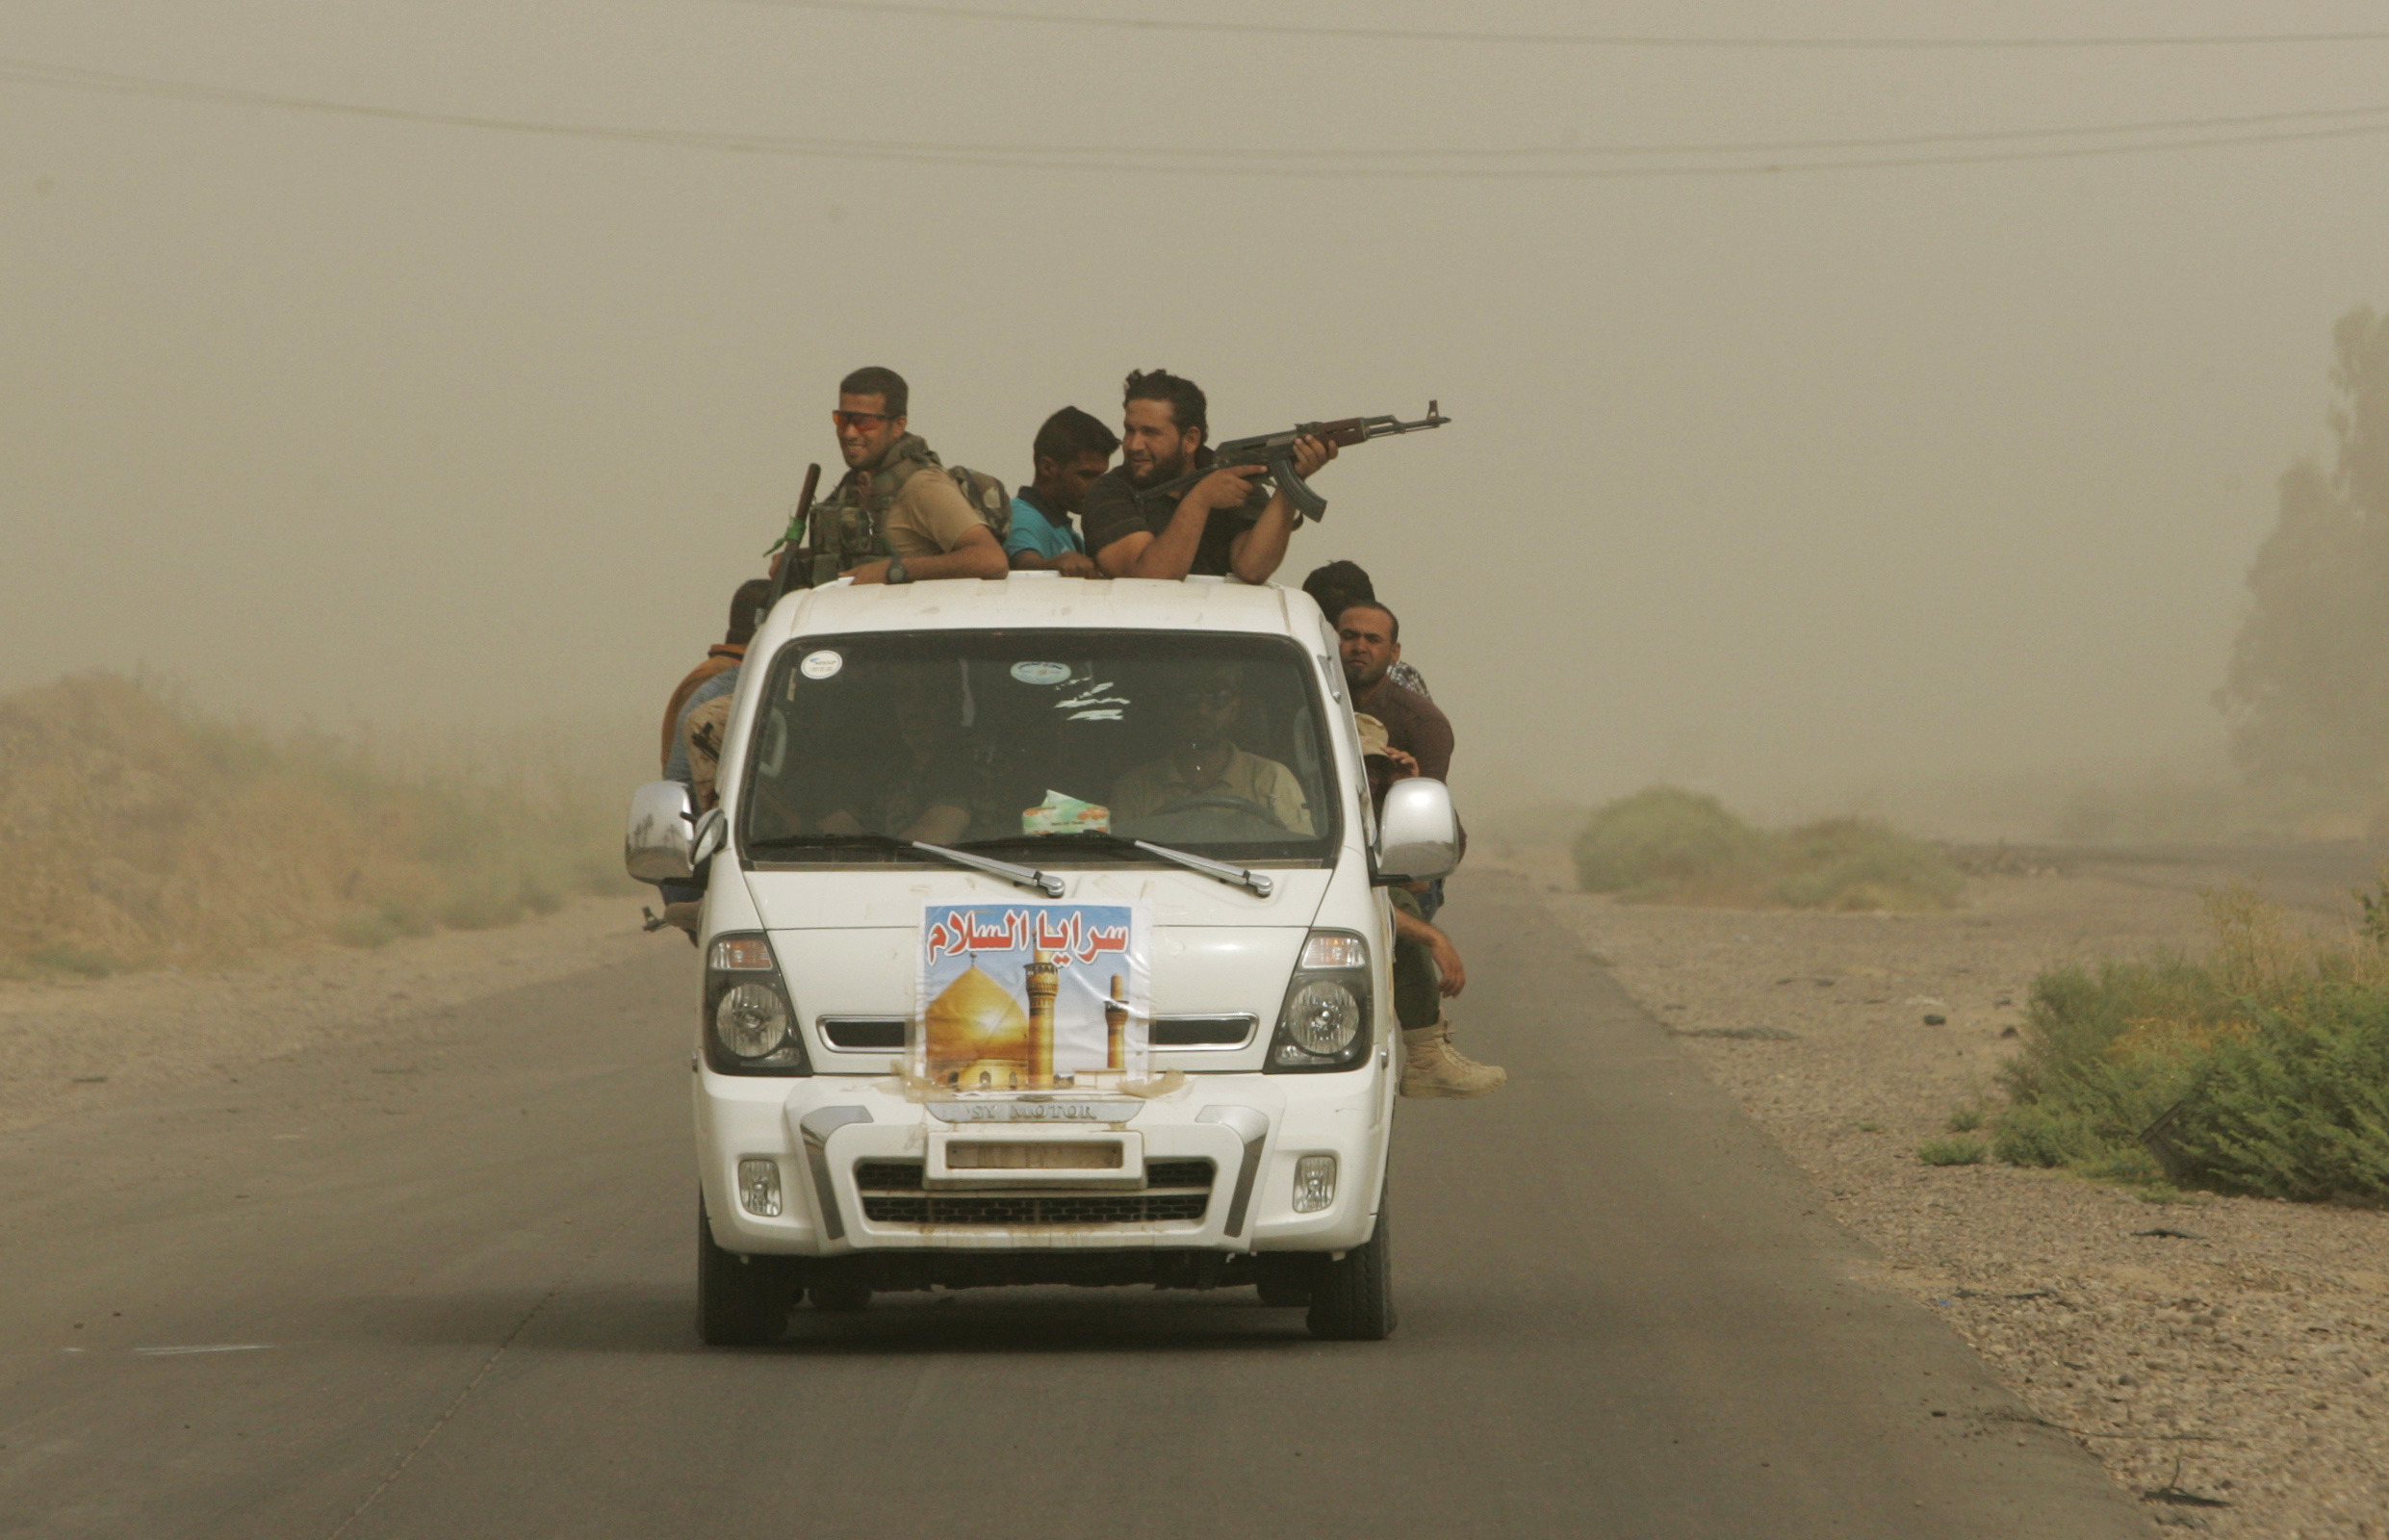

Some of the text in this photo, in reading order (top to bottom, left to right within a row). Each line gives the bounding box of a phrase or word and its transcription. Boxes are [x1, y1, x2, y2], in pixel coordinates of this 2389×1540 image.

[927, 910, 1129, 966] سرايا السلام
[1009, 1105, 1097, 1120] MOTOR
